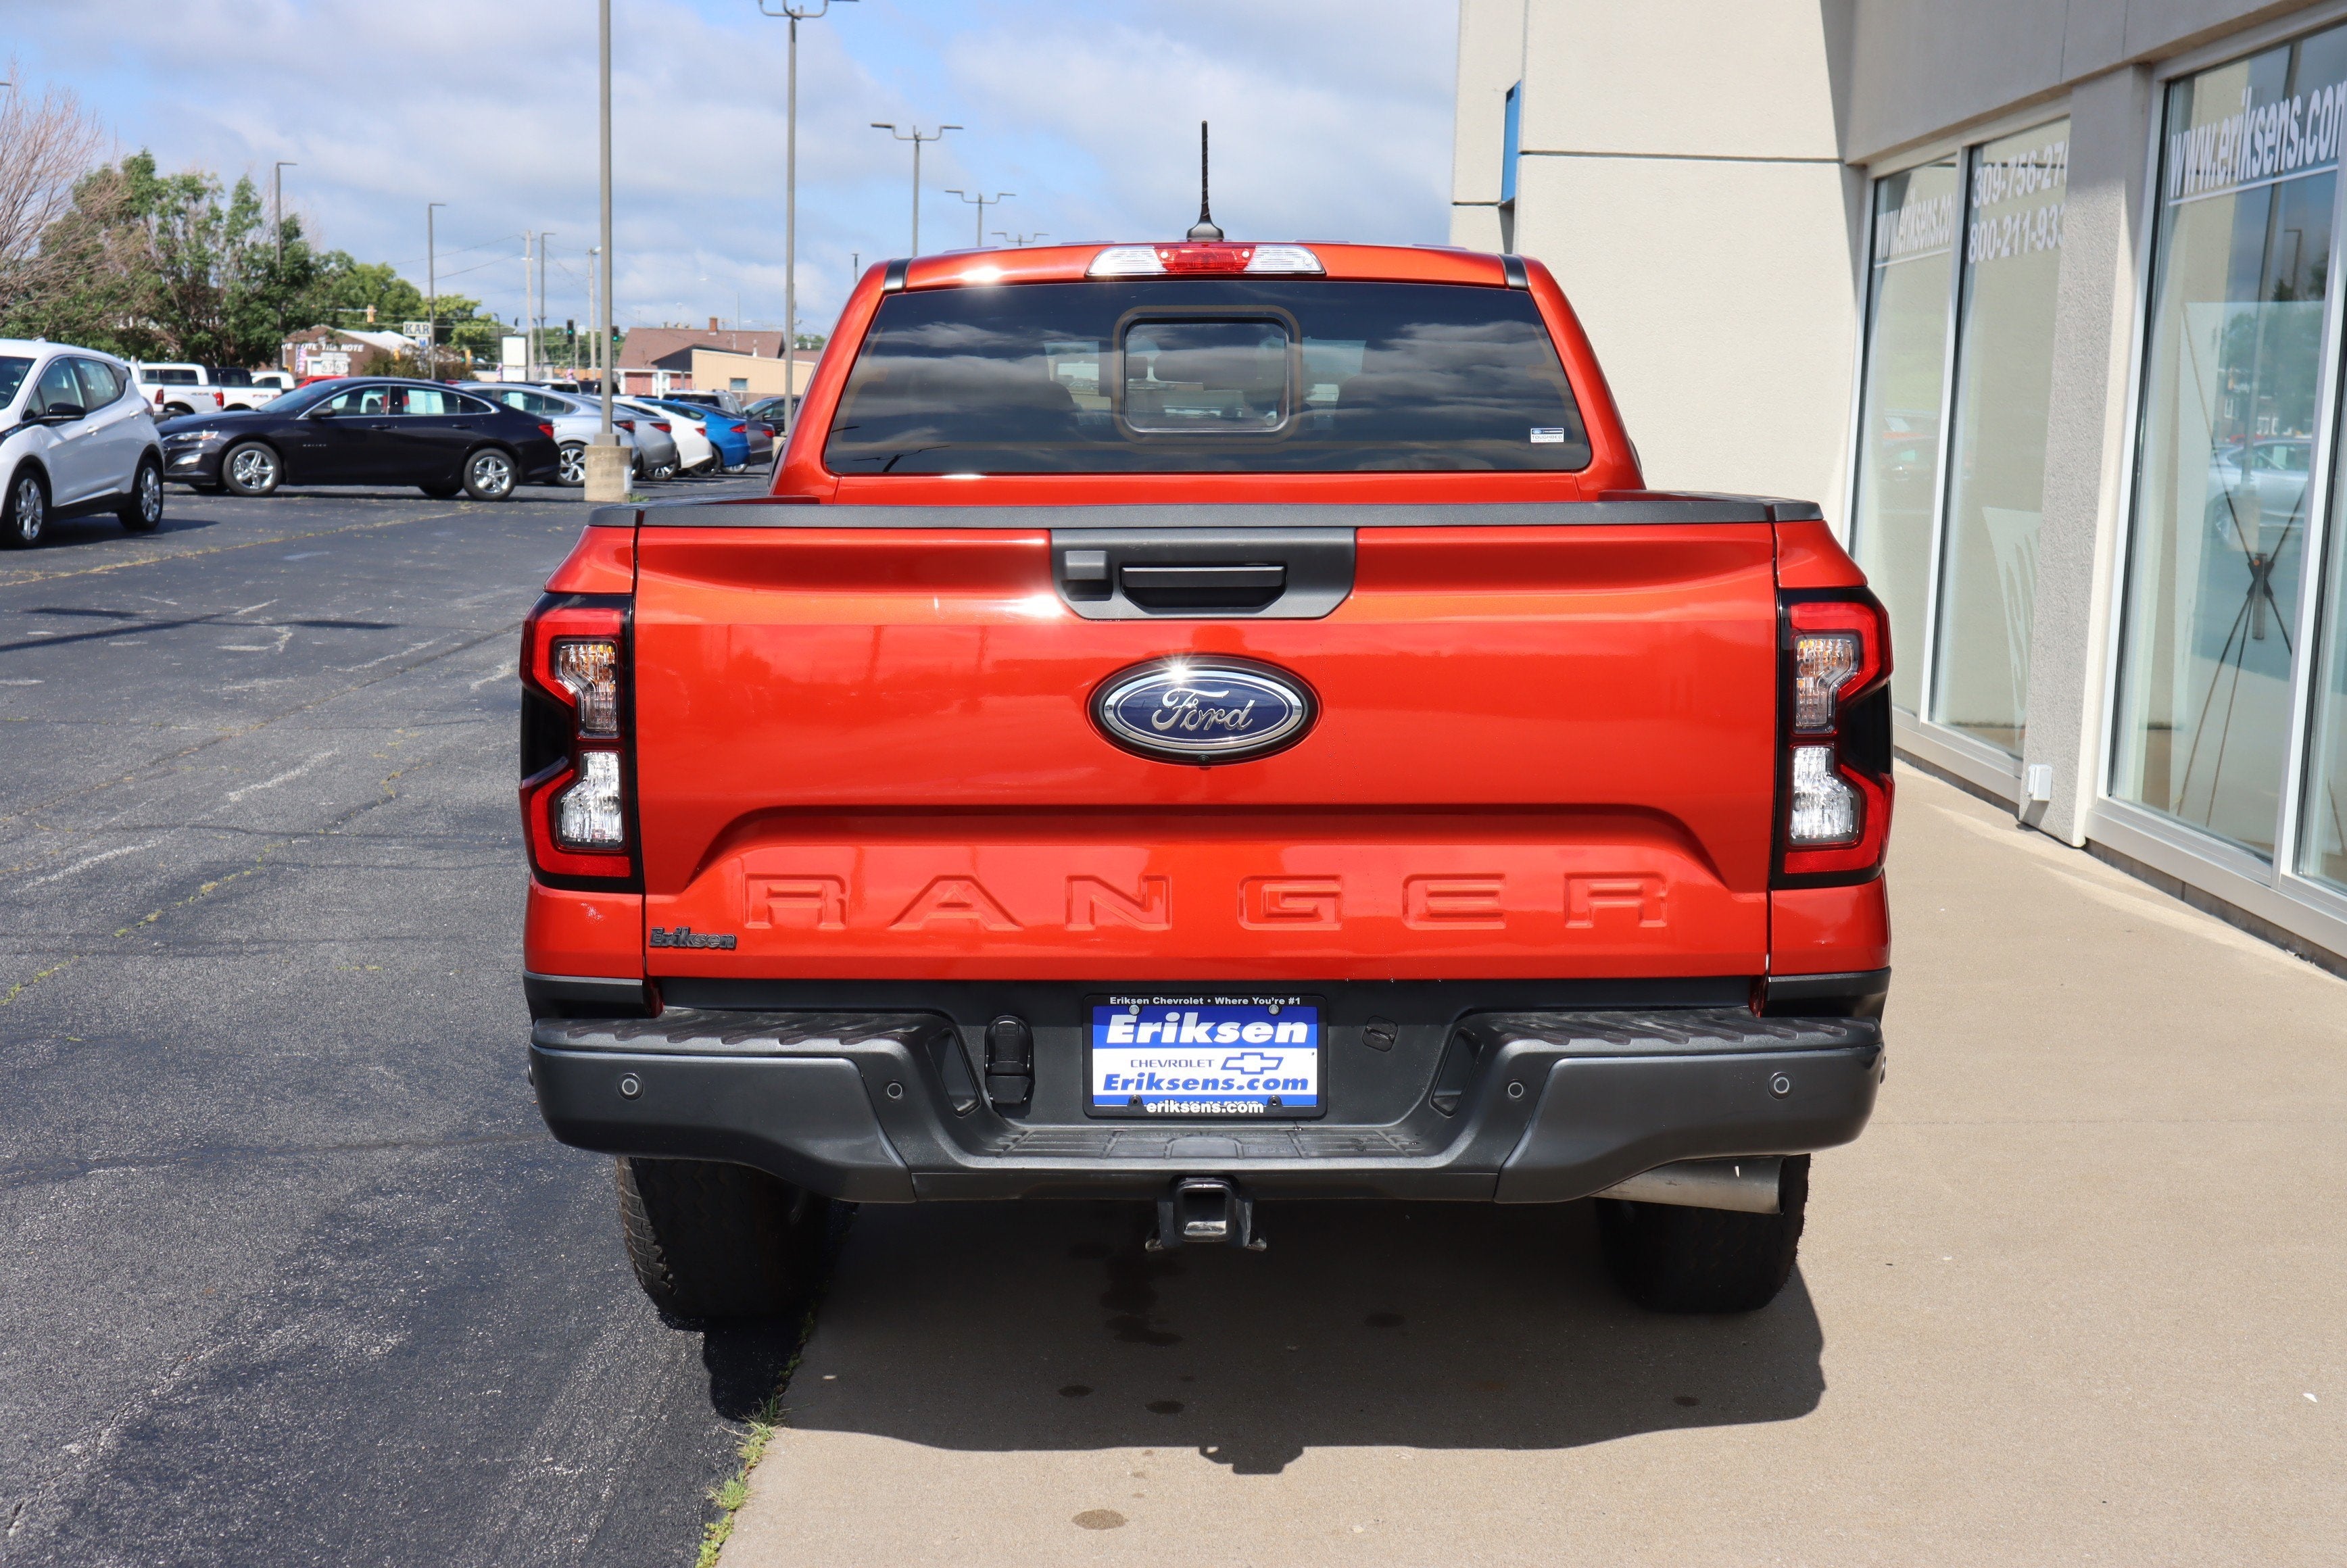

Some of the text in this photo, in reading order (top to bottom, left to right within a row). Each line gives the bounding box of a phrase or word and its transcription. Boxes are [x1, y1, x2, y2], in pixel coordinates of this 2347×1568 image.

[1973, 141, 2069, 209] 309-756-27
[406, 324, 429, 335] KAR
[341, 343, 364, 352] NOTE
[1151, 687, 1255, 731] Ford
[743, 873, 1668, 931] RANGER
[649, 927, 737, 950] Eriksen
[1110, 997, 1149, 1005] Eriksen
[1153, 997, 1203, 1005] Chevrolet
[1215, 997, 1249, 1005] Where
[1288, 997, 1301, 1005] #1
[1106, 1012, 1309, 1044] Eriksen
[1130, 1059, 1215, 1068] CHEVROLET
[1103, 1072, 1309, 1091] Eriksens.com
[1146, 1100, 1264, 1113] eriksens.com
